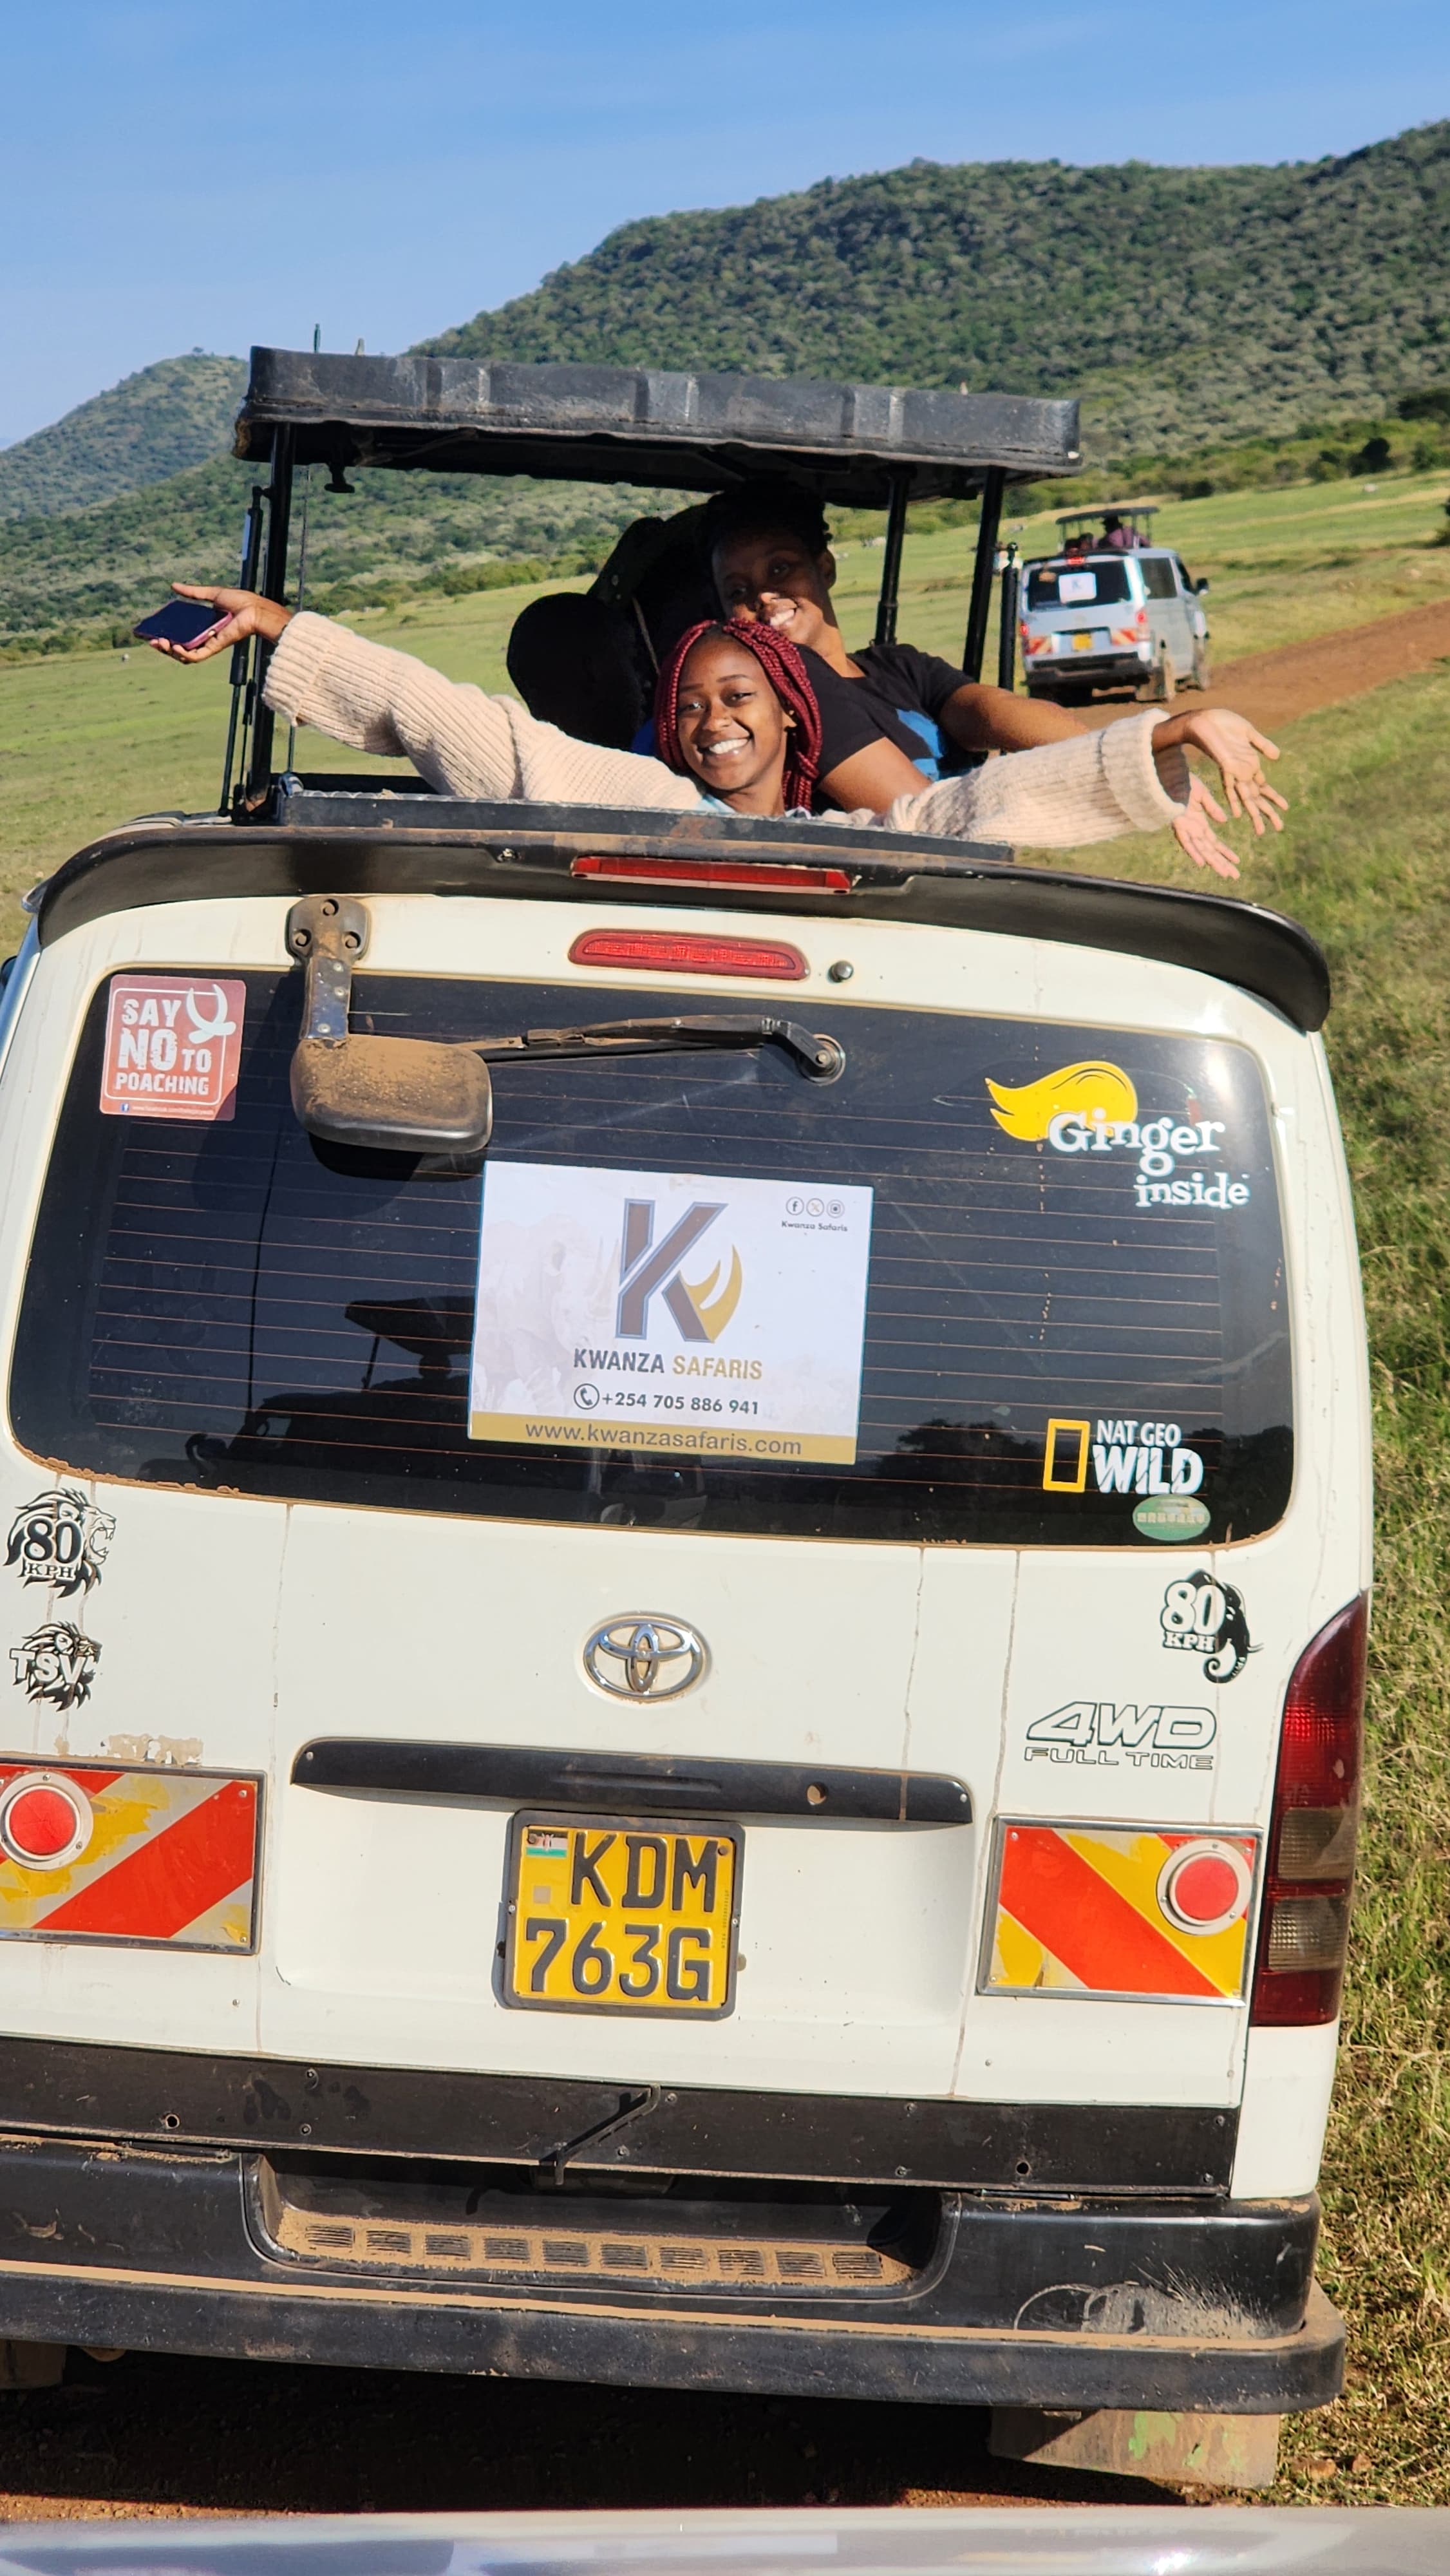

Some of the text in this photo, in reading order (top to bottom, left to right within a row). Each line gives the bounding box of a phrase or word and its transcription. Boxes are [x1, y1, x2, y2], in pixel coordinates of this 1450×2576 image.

[122, 999, 182, 1027] SAY
[118, 1027, 212, 1073] NO TO
[1048, 1107, 1226, 1177] Ginger
[1133, 1172, 1250, 1209] inside
[782, 1220, 848, 1232] Kwanza Safaris
[573, 1349, 763, 1380] KWANZA SAFARIS
[602, 1392, 758, 1415] +254 705 886 941
[525, 1423, 802, 1455] www.kwanzasafaris.com
[1097, 1419, 1182, 1448] NAT GEO
[1092, 1444, 1203, 1495] WILD
[24, 1517, 82, 1565] 80
[26, 1562, 75, 1579] KPH
[1160, 1580, 1226, 1636] 80
[1164, 1632, 1216, 1653] KPH
[10, 1649, 87, 1686] TSV
[1026, 1701, 1217, 1750] 4WD
[1024, 1747, 1214, 1770] FULL TIME
[570, 1831, 719, 1913] KDM
[525, 1917, 712, 2002] 763G
